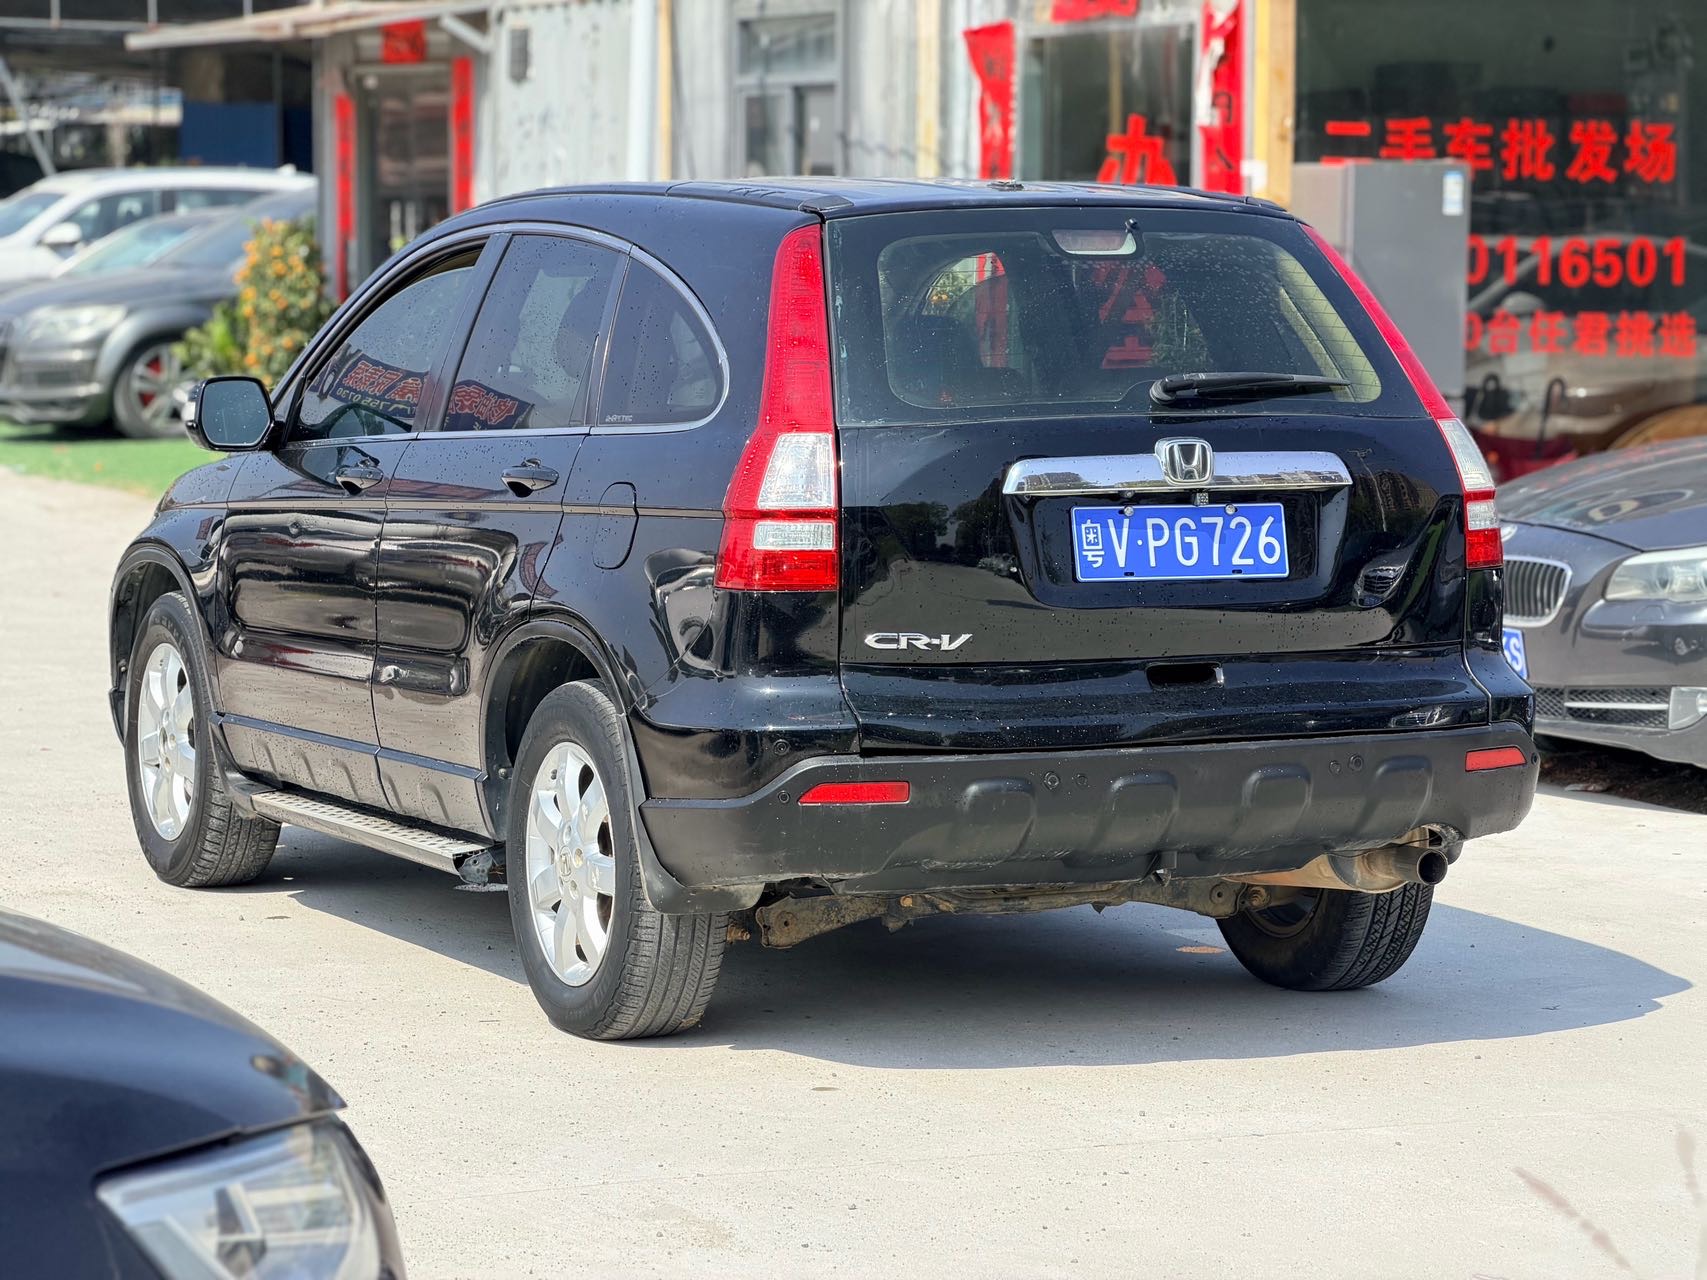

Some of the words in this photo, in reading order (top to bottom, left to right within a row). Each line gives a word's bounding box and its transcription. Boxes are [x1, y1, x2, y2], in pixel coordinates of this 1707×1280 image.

[1320, 117, 1677, 183] 二手车批发场
[864, 632, 973, 651] CR-V
